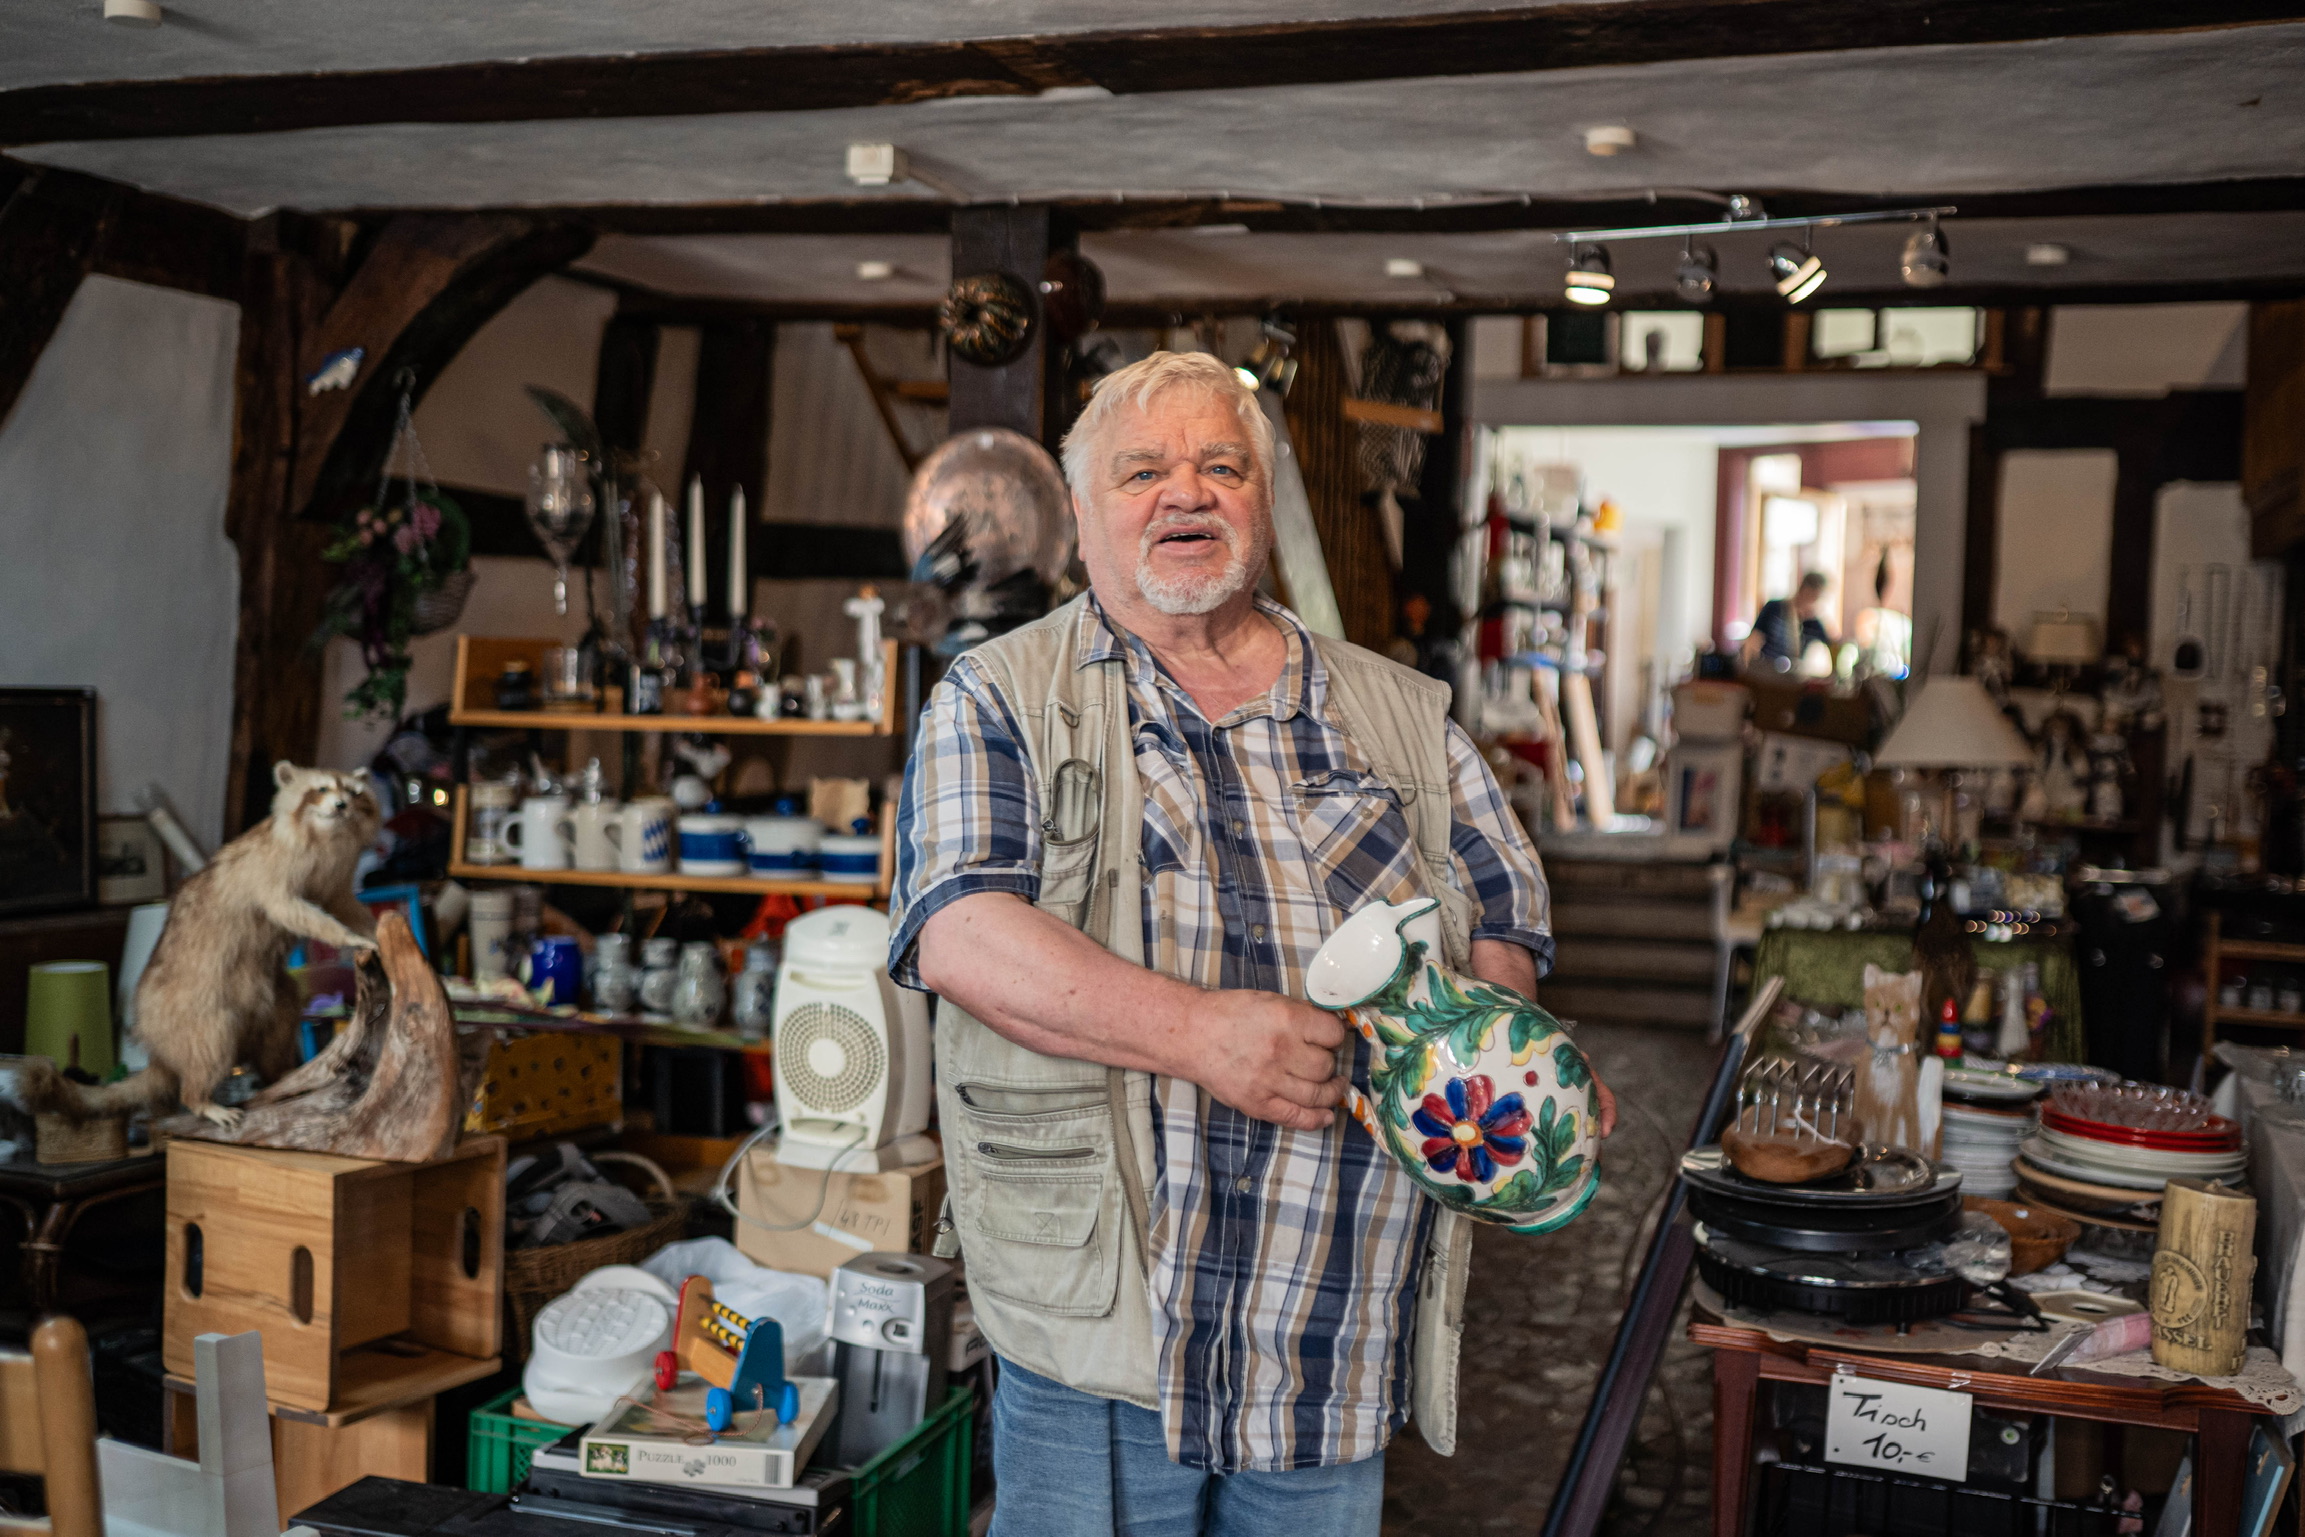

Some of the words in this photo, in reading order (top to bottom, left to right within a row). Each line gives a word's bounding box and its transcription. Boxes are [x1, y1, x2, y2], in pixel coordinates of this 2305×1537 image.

[911, 1199, 924, 1253] ASF
[860, 1282, 894, 1297] Soda
[858, 1298, 896, 1314] Maxx
[1843, 1391, 1926, 1432] Tisch
[638, 1450, 685, 1465] PUZZLE
[707, 1454, 737, 1467] 1000
